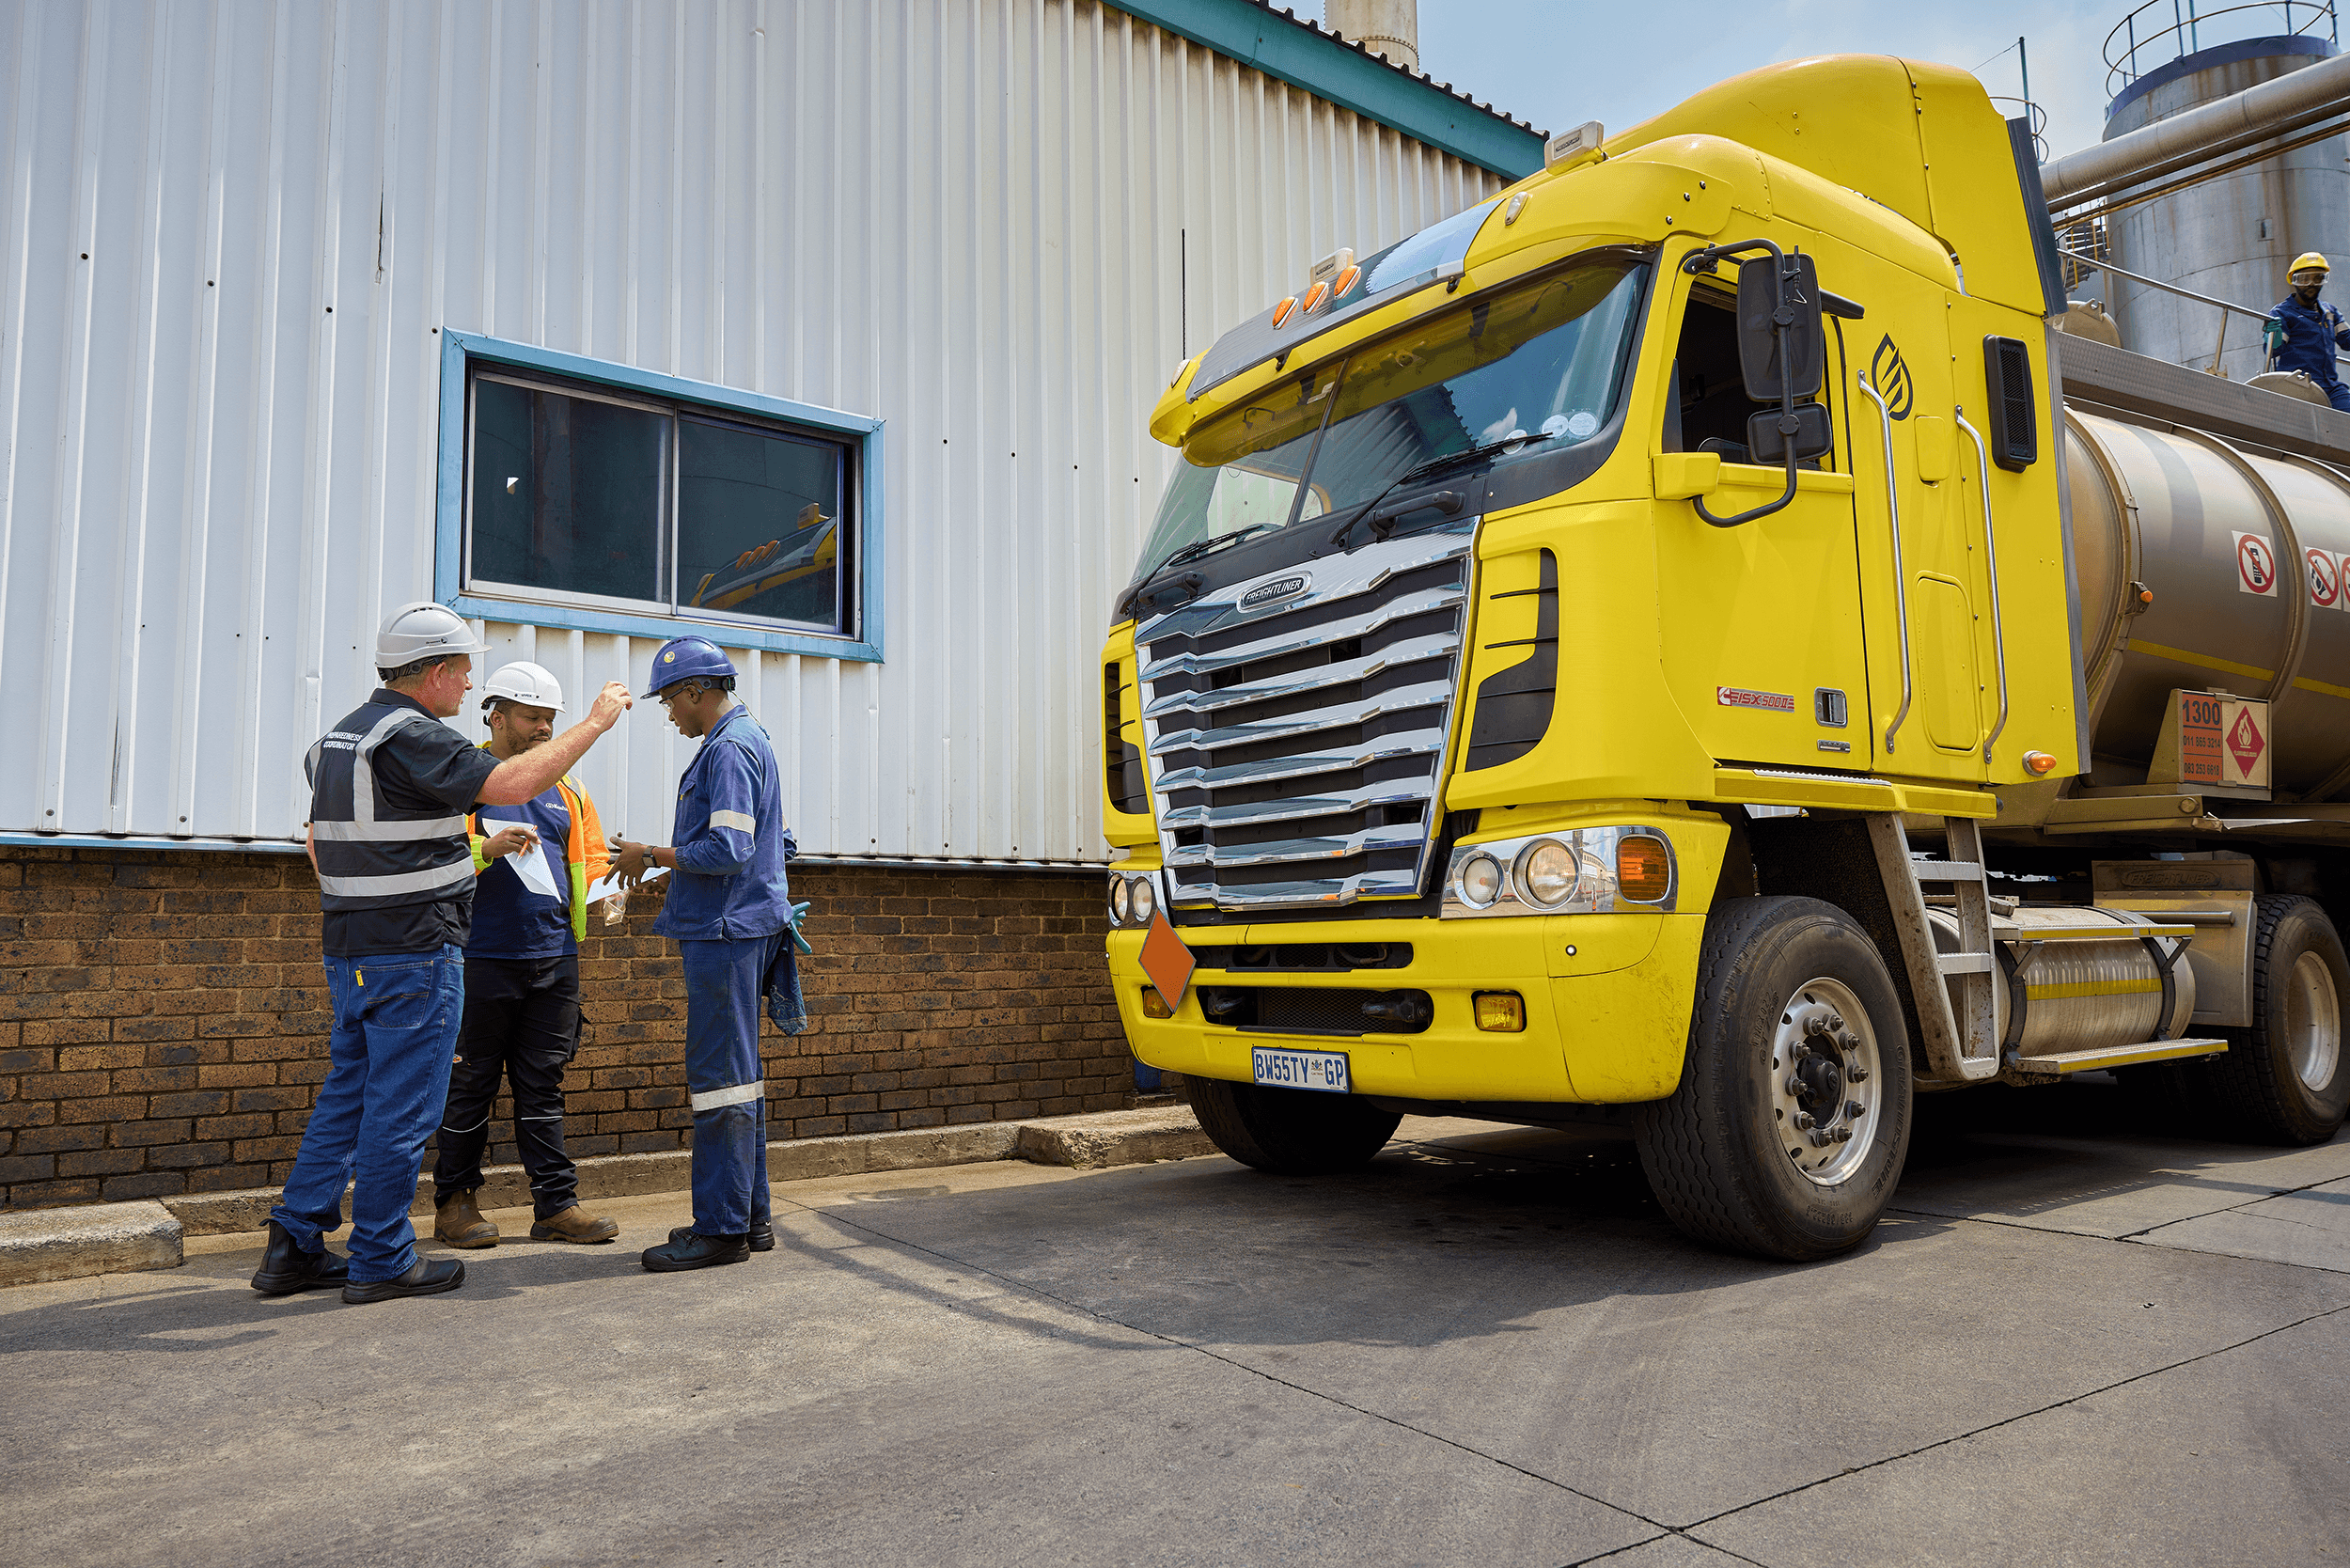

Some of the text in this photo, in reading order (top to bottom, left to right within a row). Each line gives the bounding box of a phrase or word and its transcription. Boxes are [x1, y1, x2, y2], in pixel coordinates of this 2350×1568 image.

[1246, 579, 1302, 603] FREIGHTLINER
[2182, 699, 2220, 725] 1300
[2183, 735, 2194, 746] 011
[2184, 762, 2195, 774] 083
[2131, 872, 2211, 884] FREIGHTLINER
[1256, 1054, 1344, 1086] BW55TY GP
